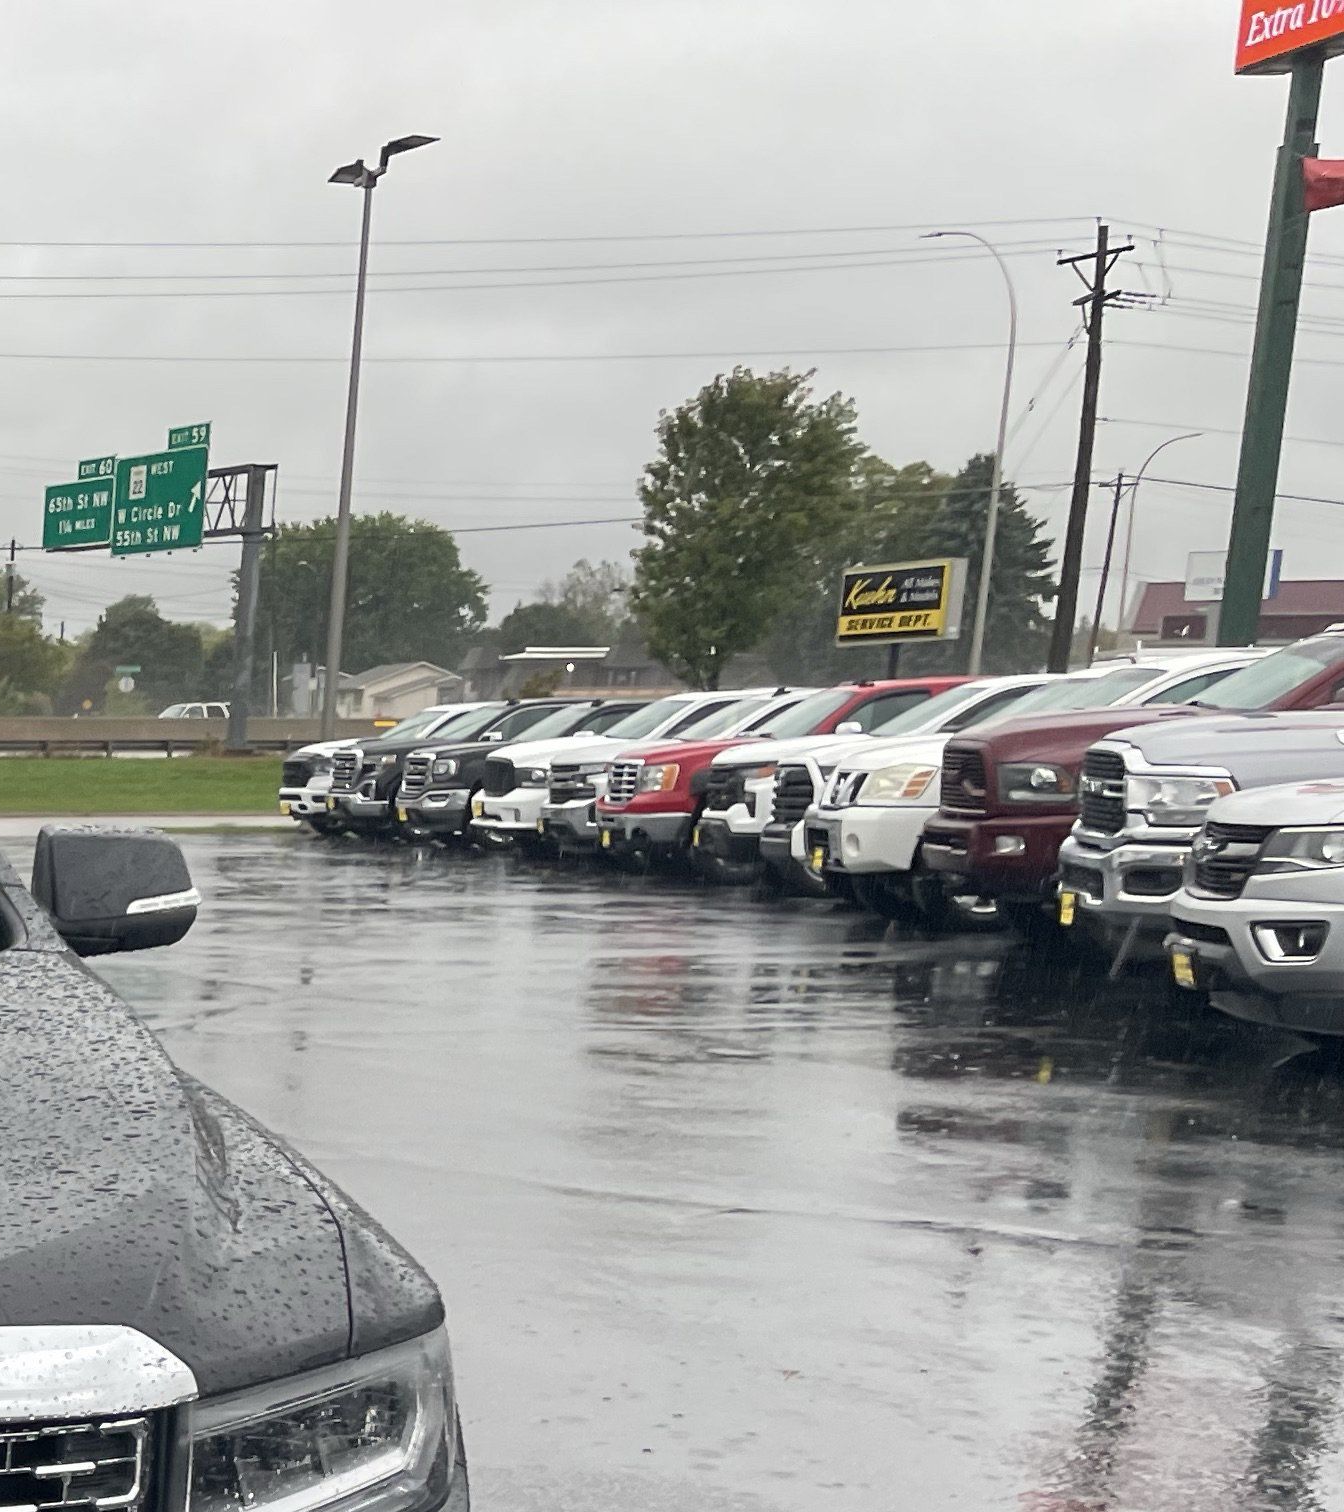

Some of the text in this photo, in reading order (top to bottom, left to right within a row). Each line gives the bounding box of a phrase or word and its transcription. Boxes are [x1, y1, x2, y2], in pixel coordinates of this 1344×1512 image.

[1245, 3, 1305, 47] Extra
[192, 426, 207, 444] 59
[98, 458, 113, 475] 60
[151, 460, 174, 475] WEST
[48, 490, 109, 513] 65th St NW
[117, 501, 182, 524] W Circle Dr
[115, 524, 181, 547] 55th St NW
[846, 616, 895, 632] SERVICE
